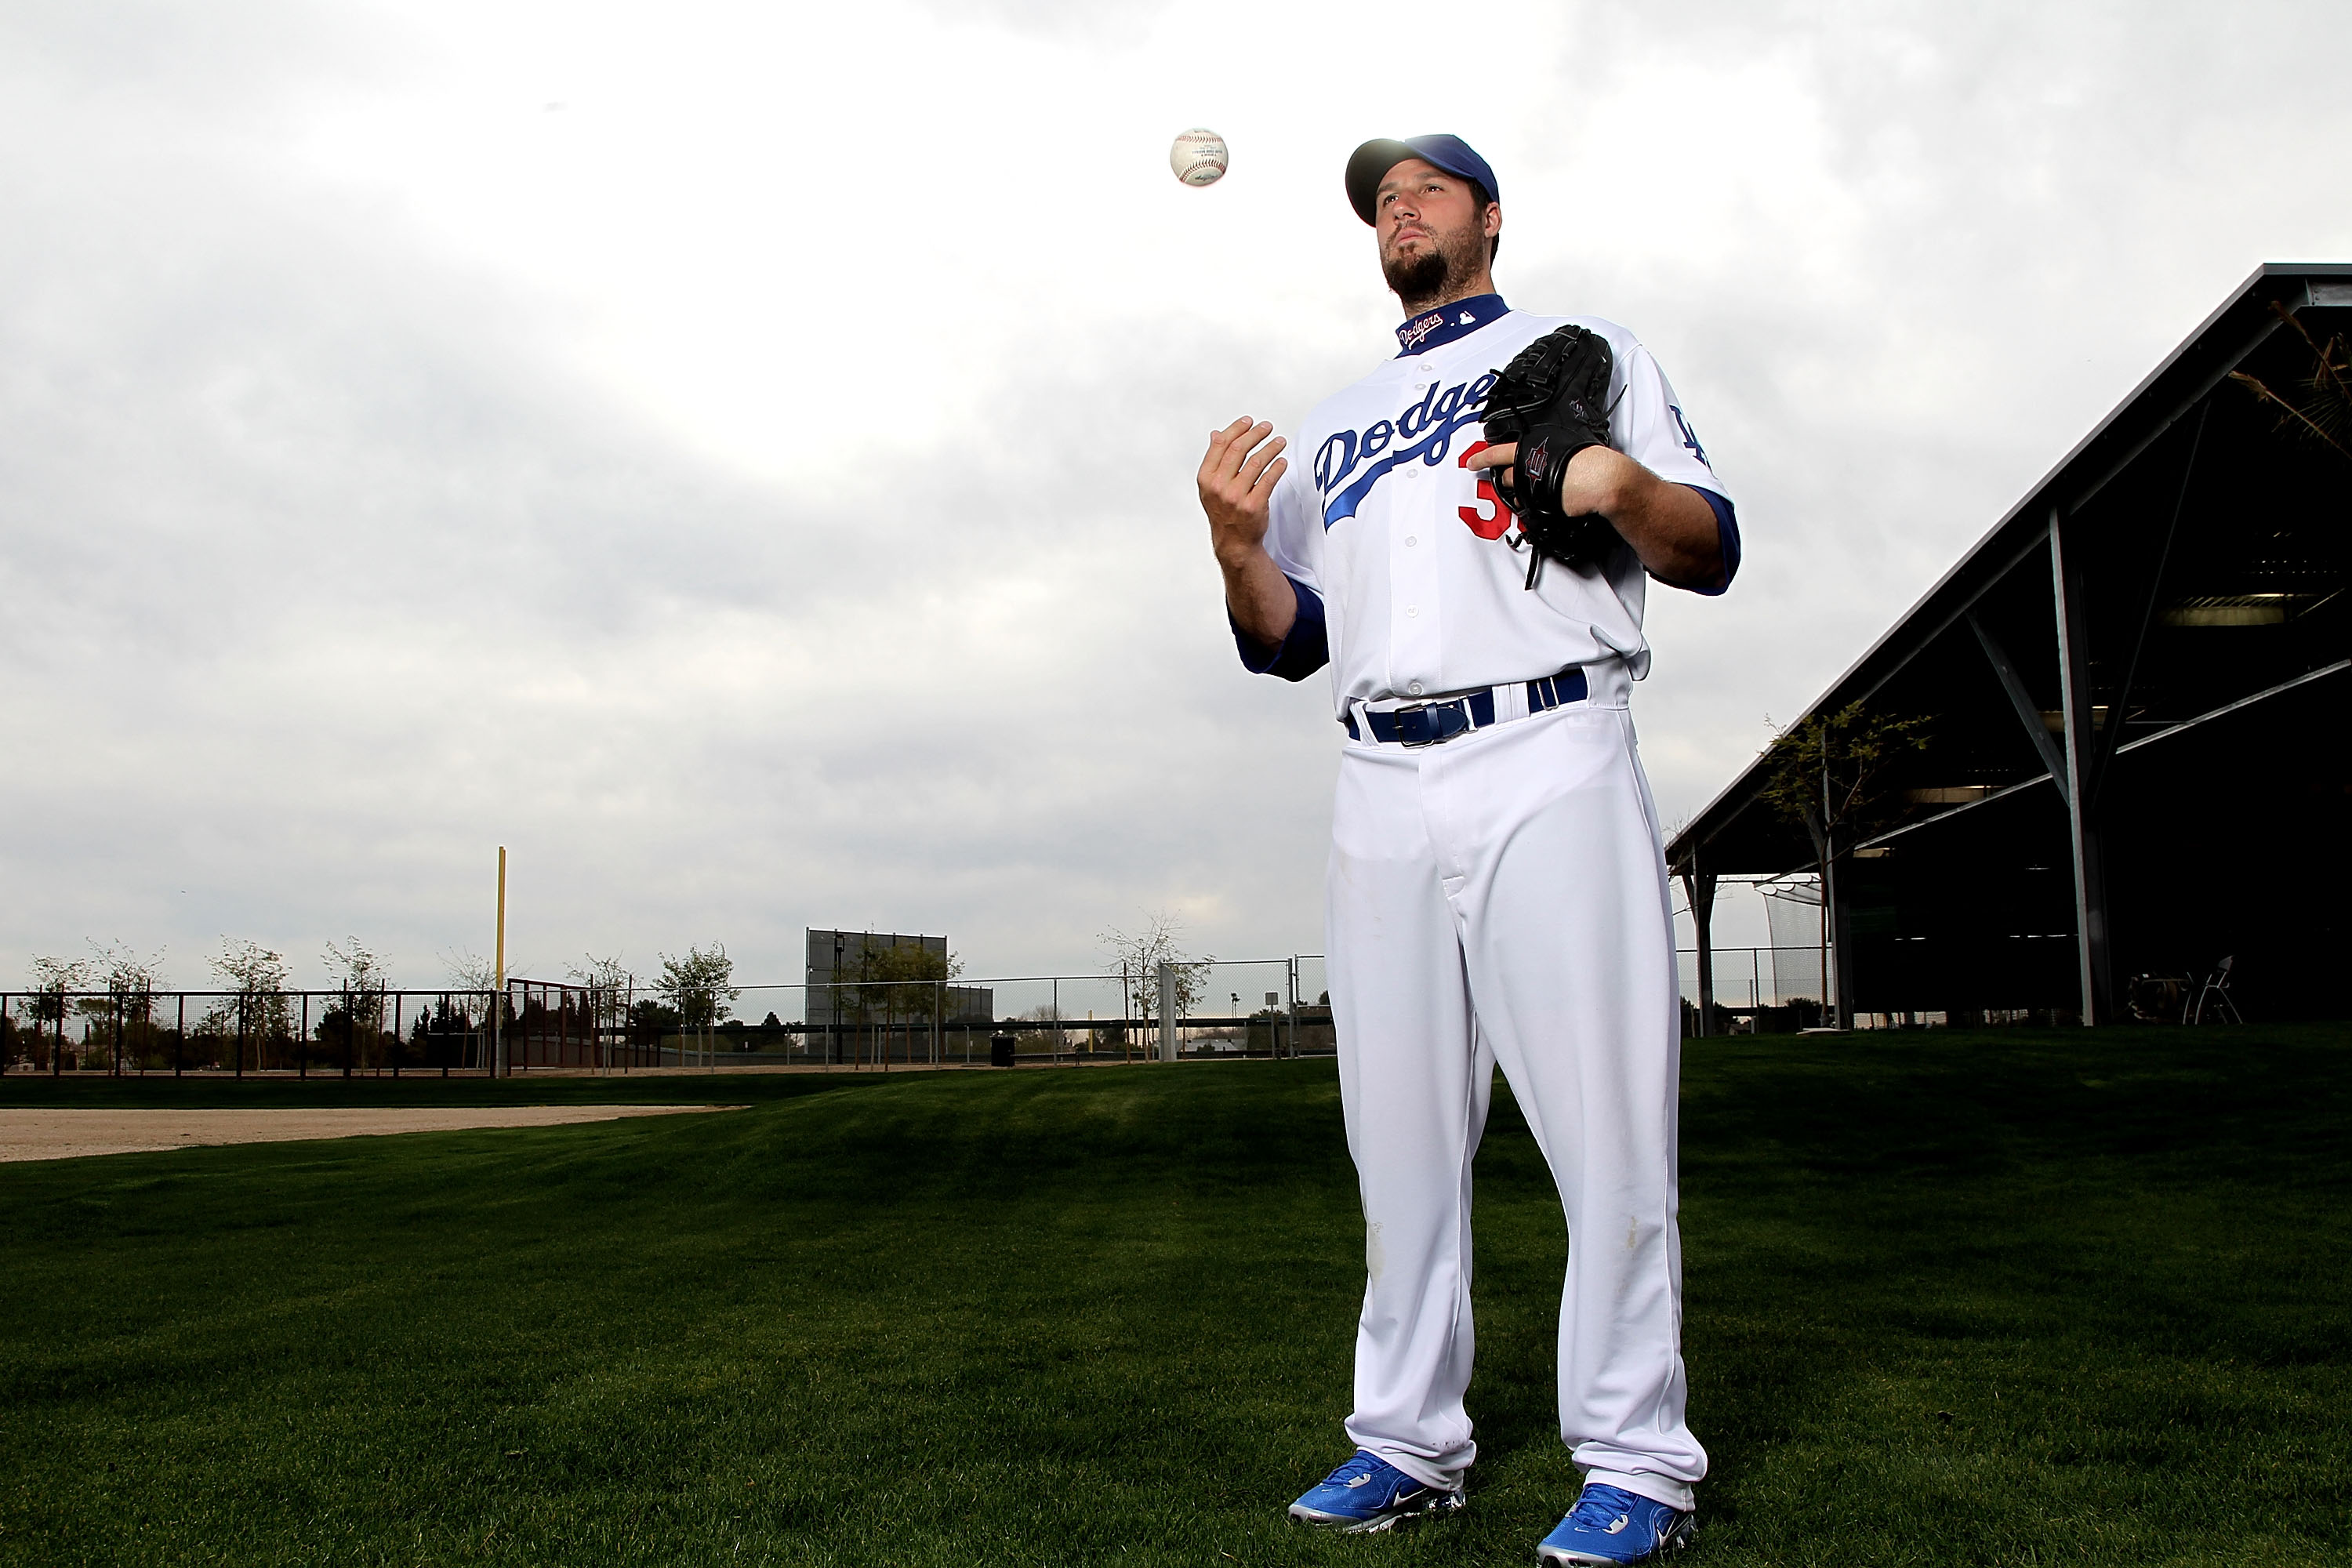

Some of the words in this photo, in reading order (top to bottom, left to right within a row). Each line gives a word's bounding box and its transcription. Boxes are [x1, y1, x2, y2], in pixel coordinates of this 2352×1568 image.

[1399, 313, 1443, 350] Dodgers
[1314, 373, 1497, 535] Dodge
[1458, 441, 1527, 544] 3
